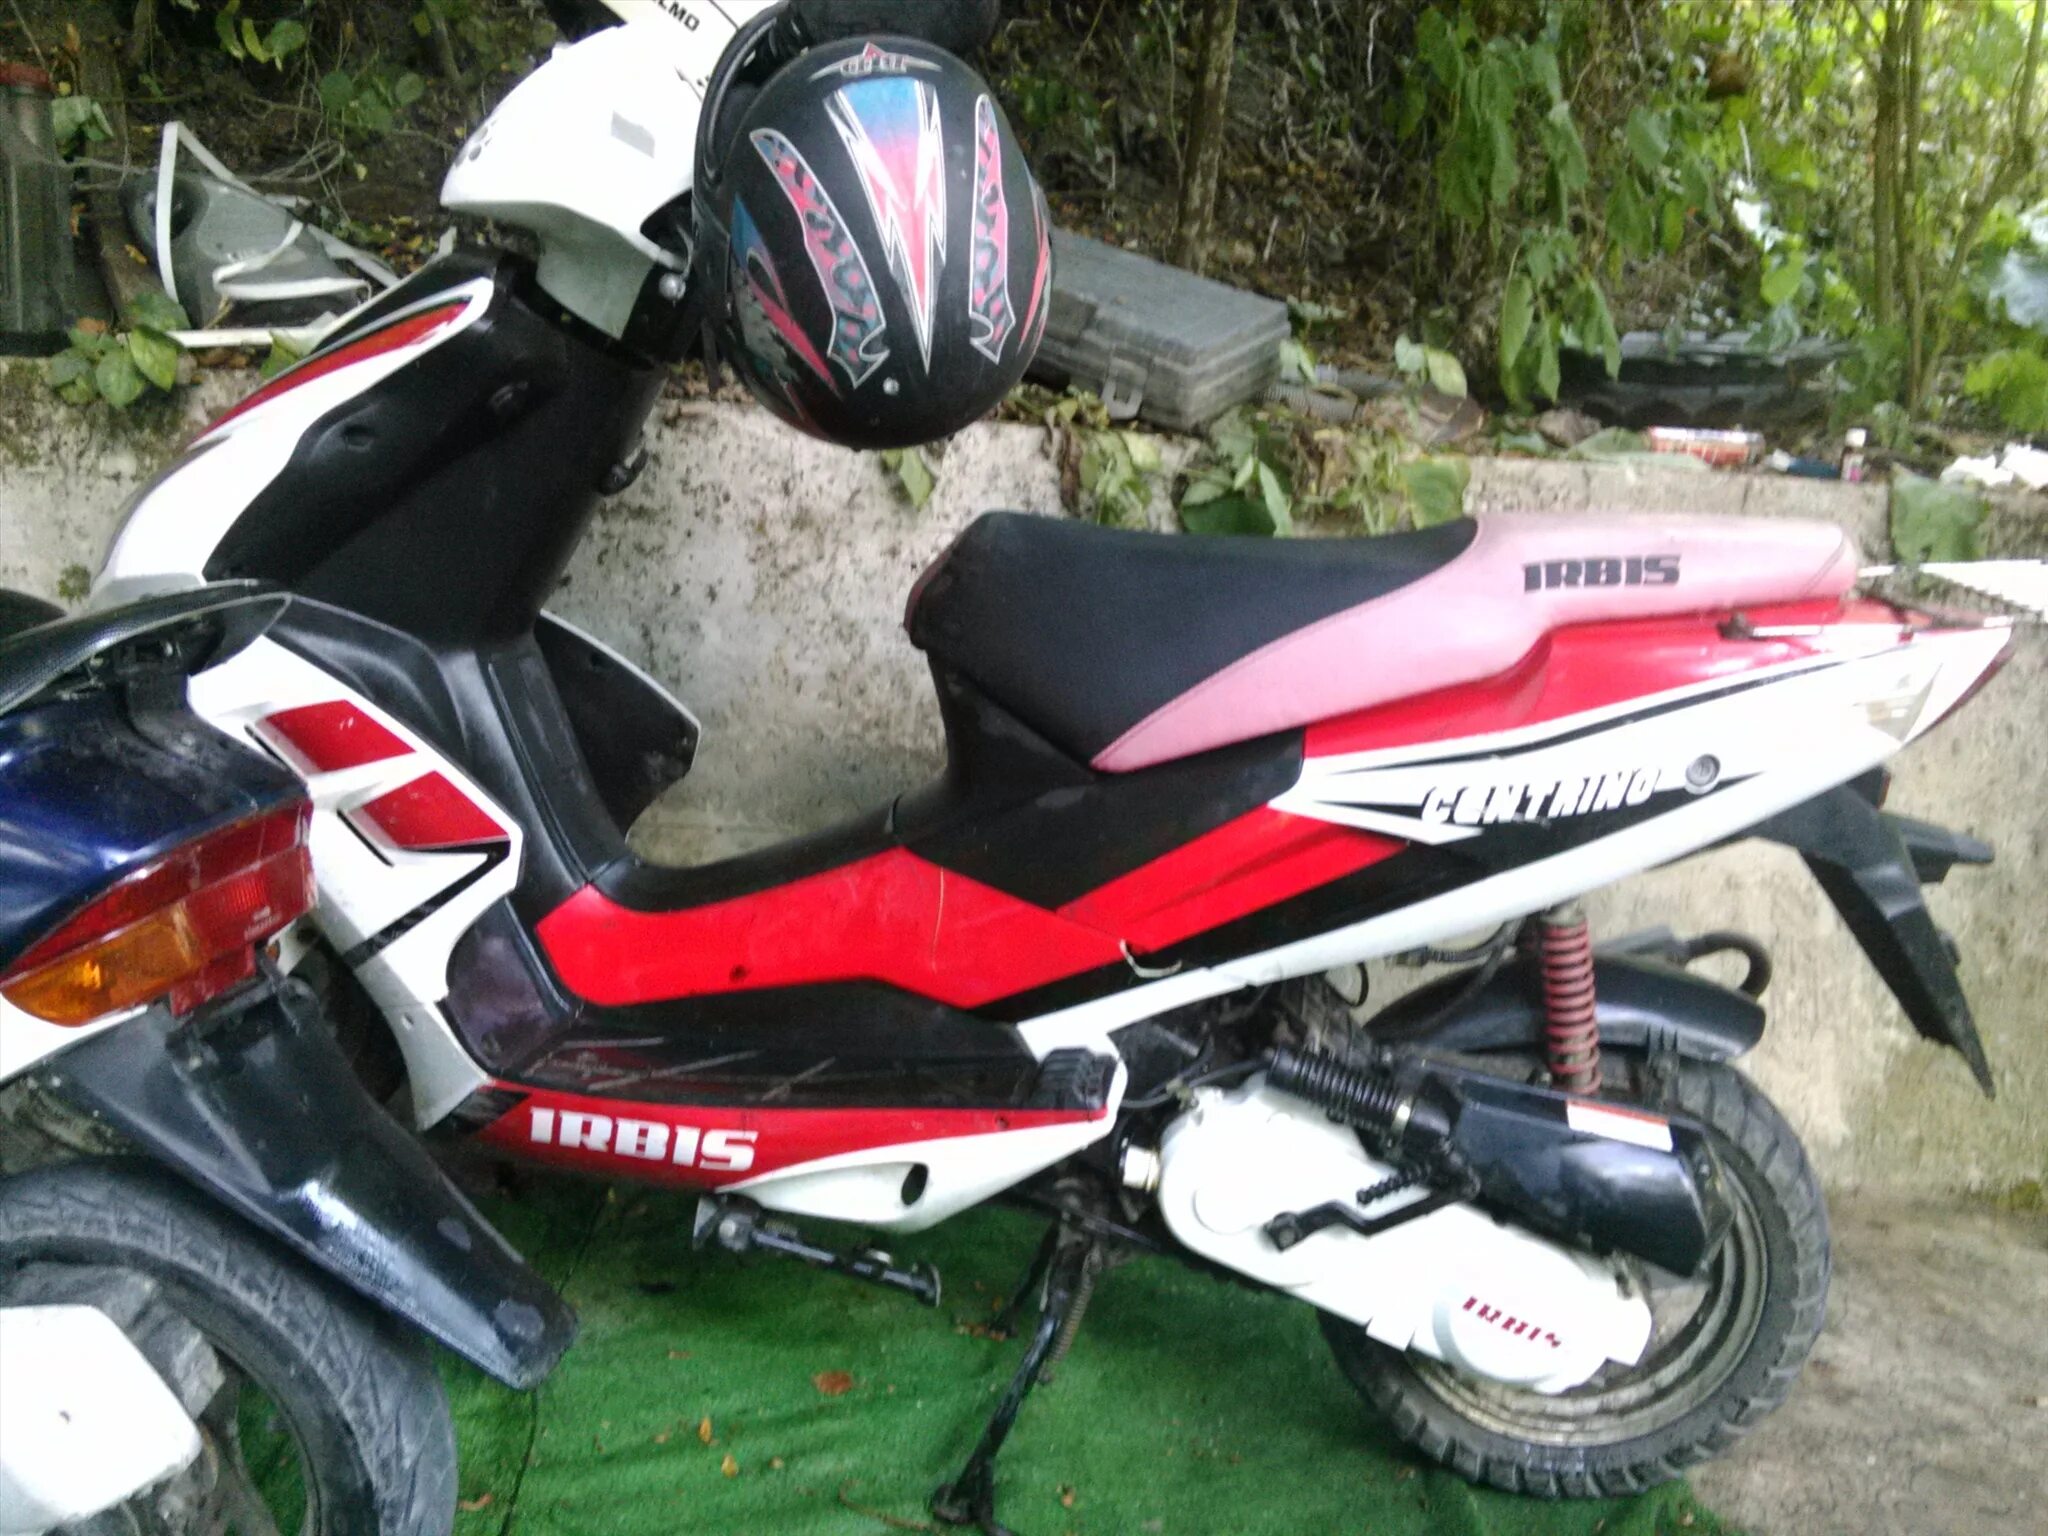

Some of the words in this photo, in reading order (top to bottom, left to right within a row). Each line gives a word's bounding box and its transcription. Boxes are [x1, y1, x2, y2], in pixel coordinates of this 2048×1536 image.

[1523, 555, 1680, 594] IRBIS
[1421, 768, 1662, 825] CENTRINO
[530, 1107, 759, 1171] IRBIS
